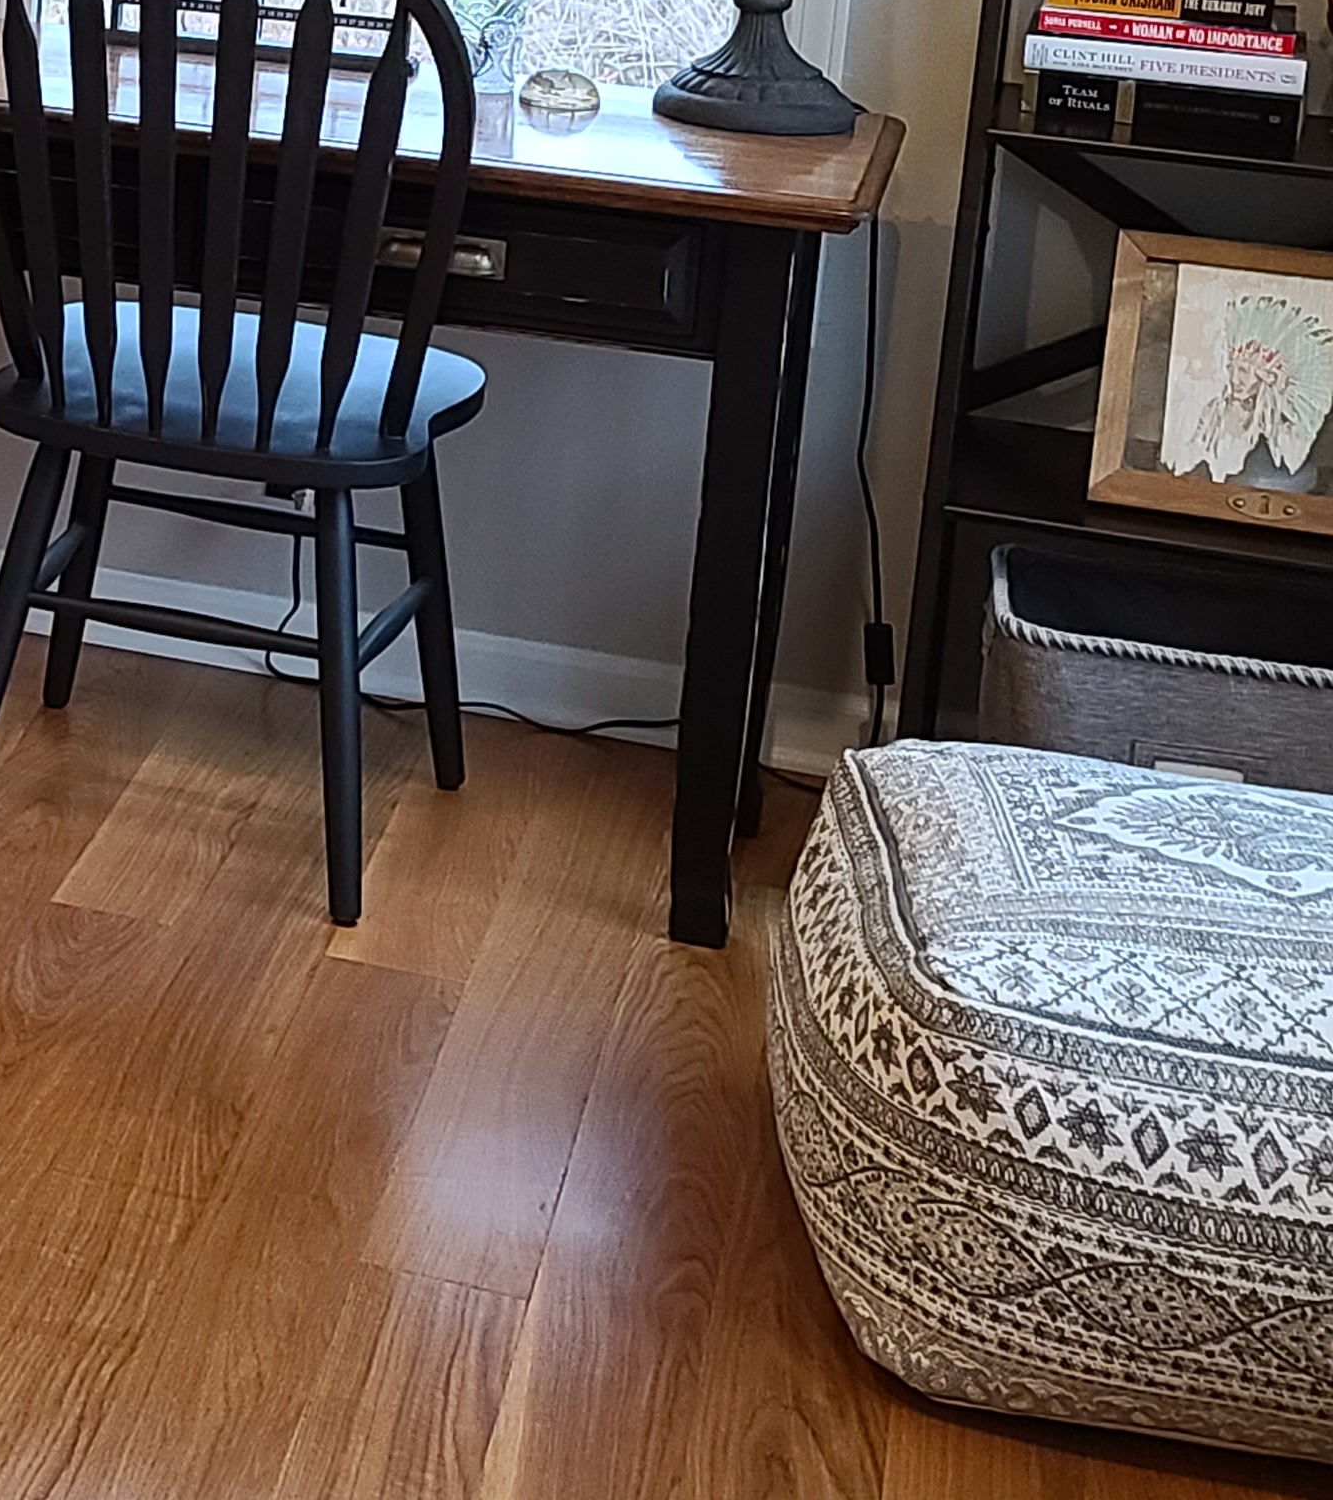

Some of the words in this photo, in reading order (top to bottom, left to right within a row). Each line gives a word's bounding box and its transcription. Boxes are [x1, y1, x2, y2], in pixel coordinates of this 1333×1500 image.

[1244, 2, 1267, 17] JURY
[1068, 18, 1102, 31] PURNELL
[1123, 24, 1130, 33] A
[1132, 22, 1173, 40] WOMAN
[1188, 27, 1205, 43] NO
[1206, 30, 1284, 52] IMPORTANCE
[1052, 48, 1098, 62] CLINT
[1101, 53, 1135, 65] HILL
[1139, 60, 1177, 74] FIVE
[1180, 63, 1276, 83] PRESIDENTS
[1062, 84, 1098, 98] TEAM
[1067, 97, 1111, 112] RIVALS
